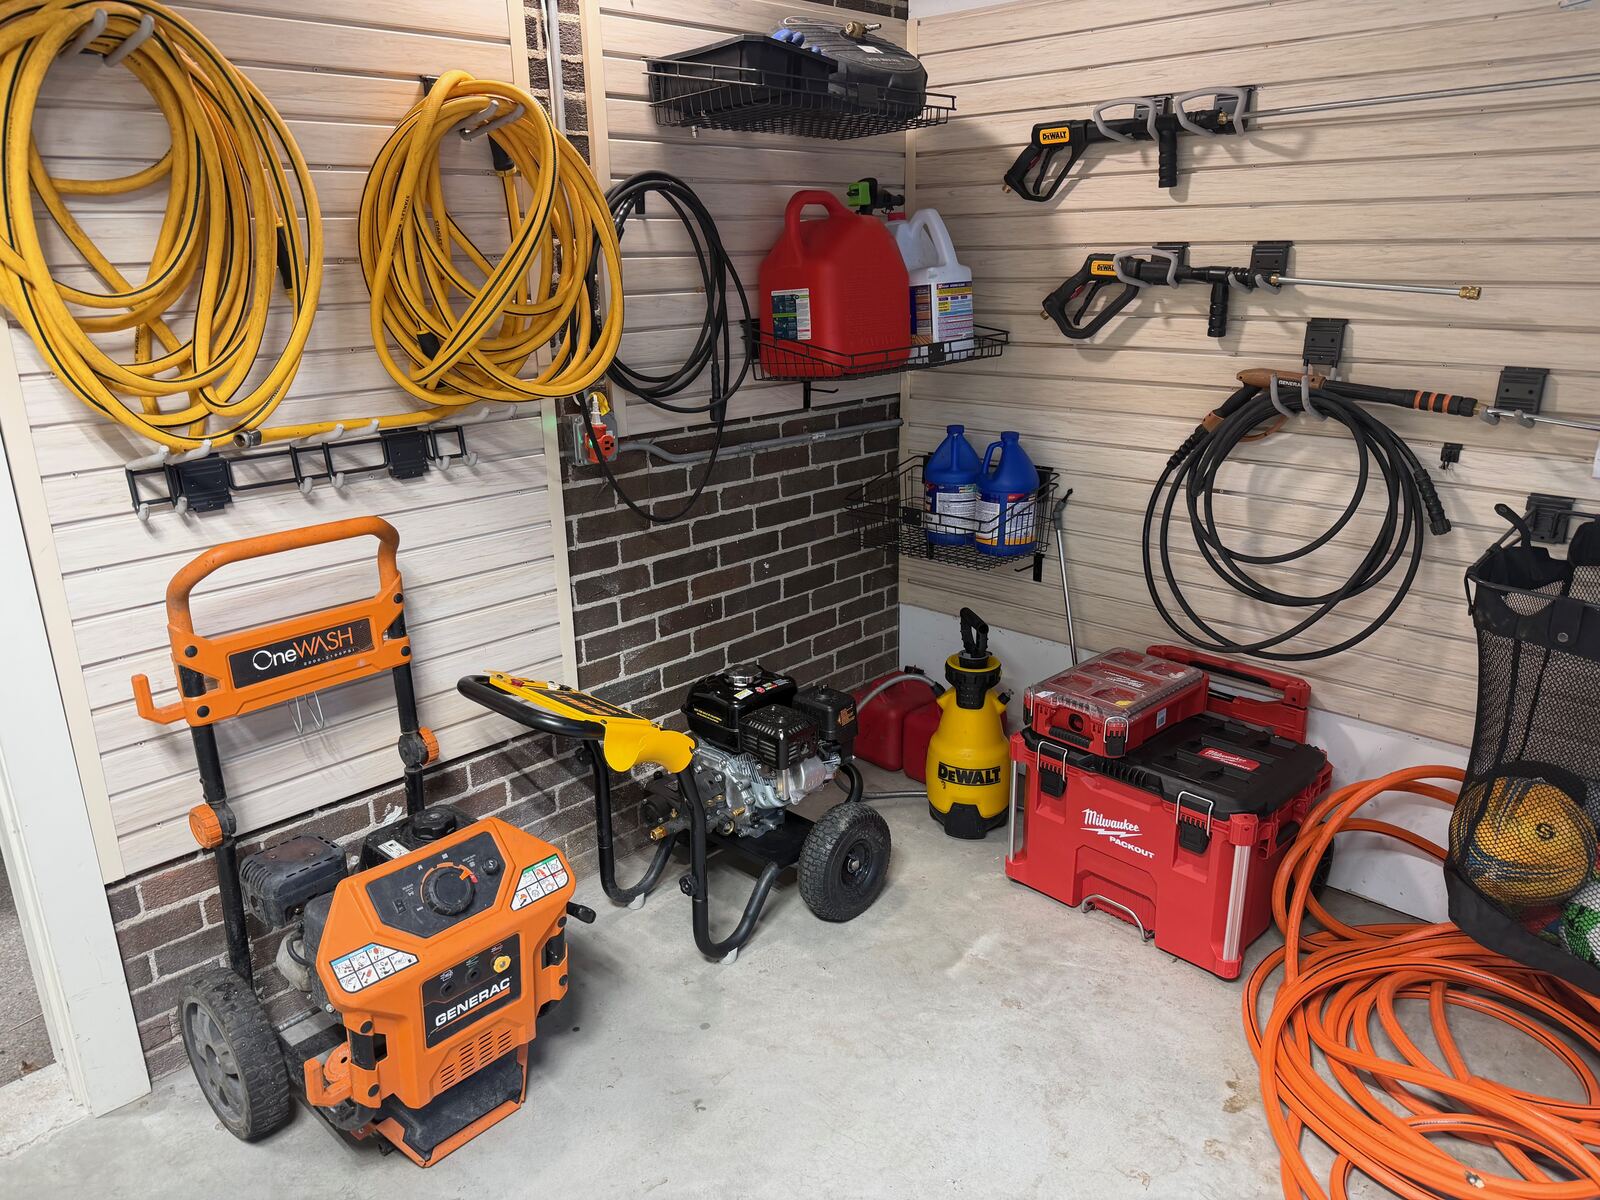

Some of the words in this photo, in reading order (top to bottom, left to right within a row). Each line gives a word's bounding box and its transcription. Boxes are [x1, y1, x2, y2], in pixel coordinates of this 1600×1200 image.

[1278, 379, 1302, 388] GENERA
[938, 764, 1001, 785] DEWALT
[1081, 808, 1140, 832] Milwaukee
[1109, 836, 1155, 859] PACKOUT
[435, 977, 511, 1027] GENERAC
